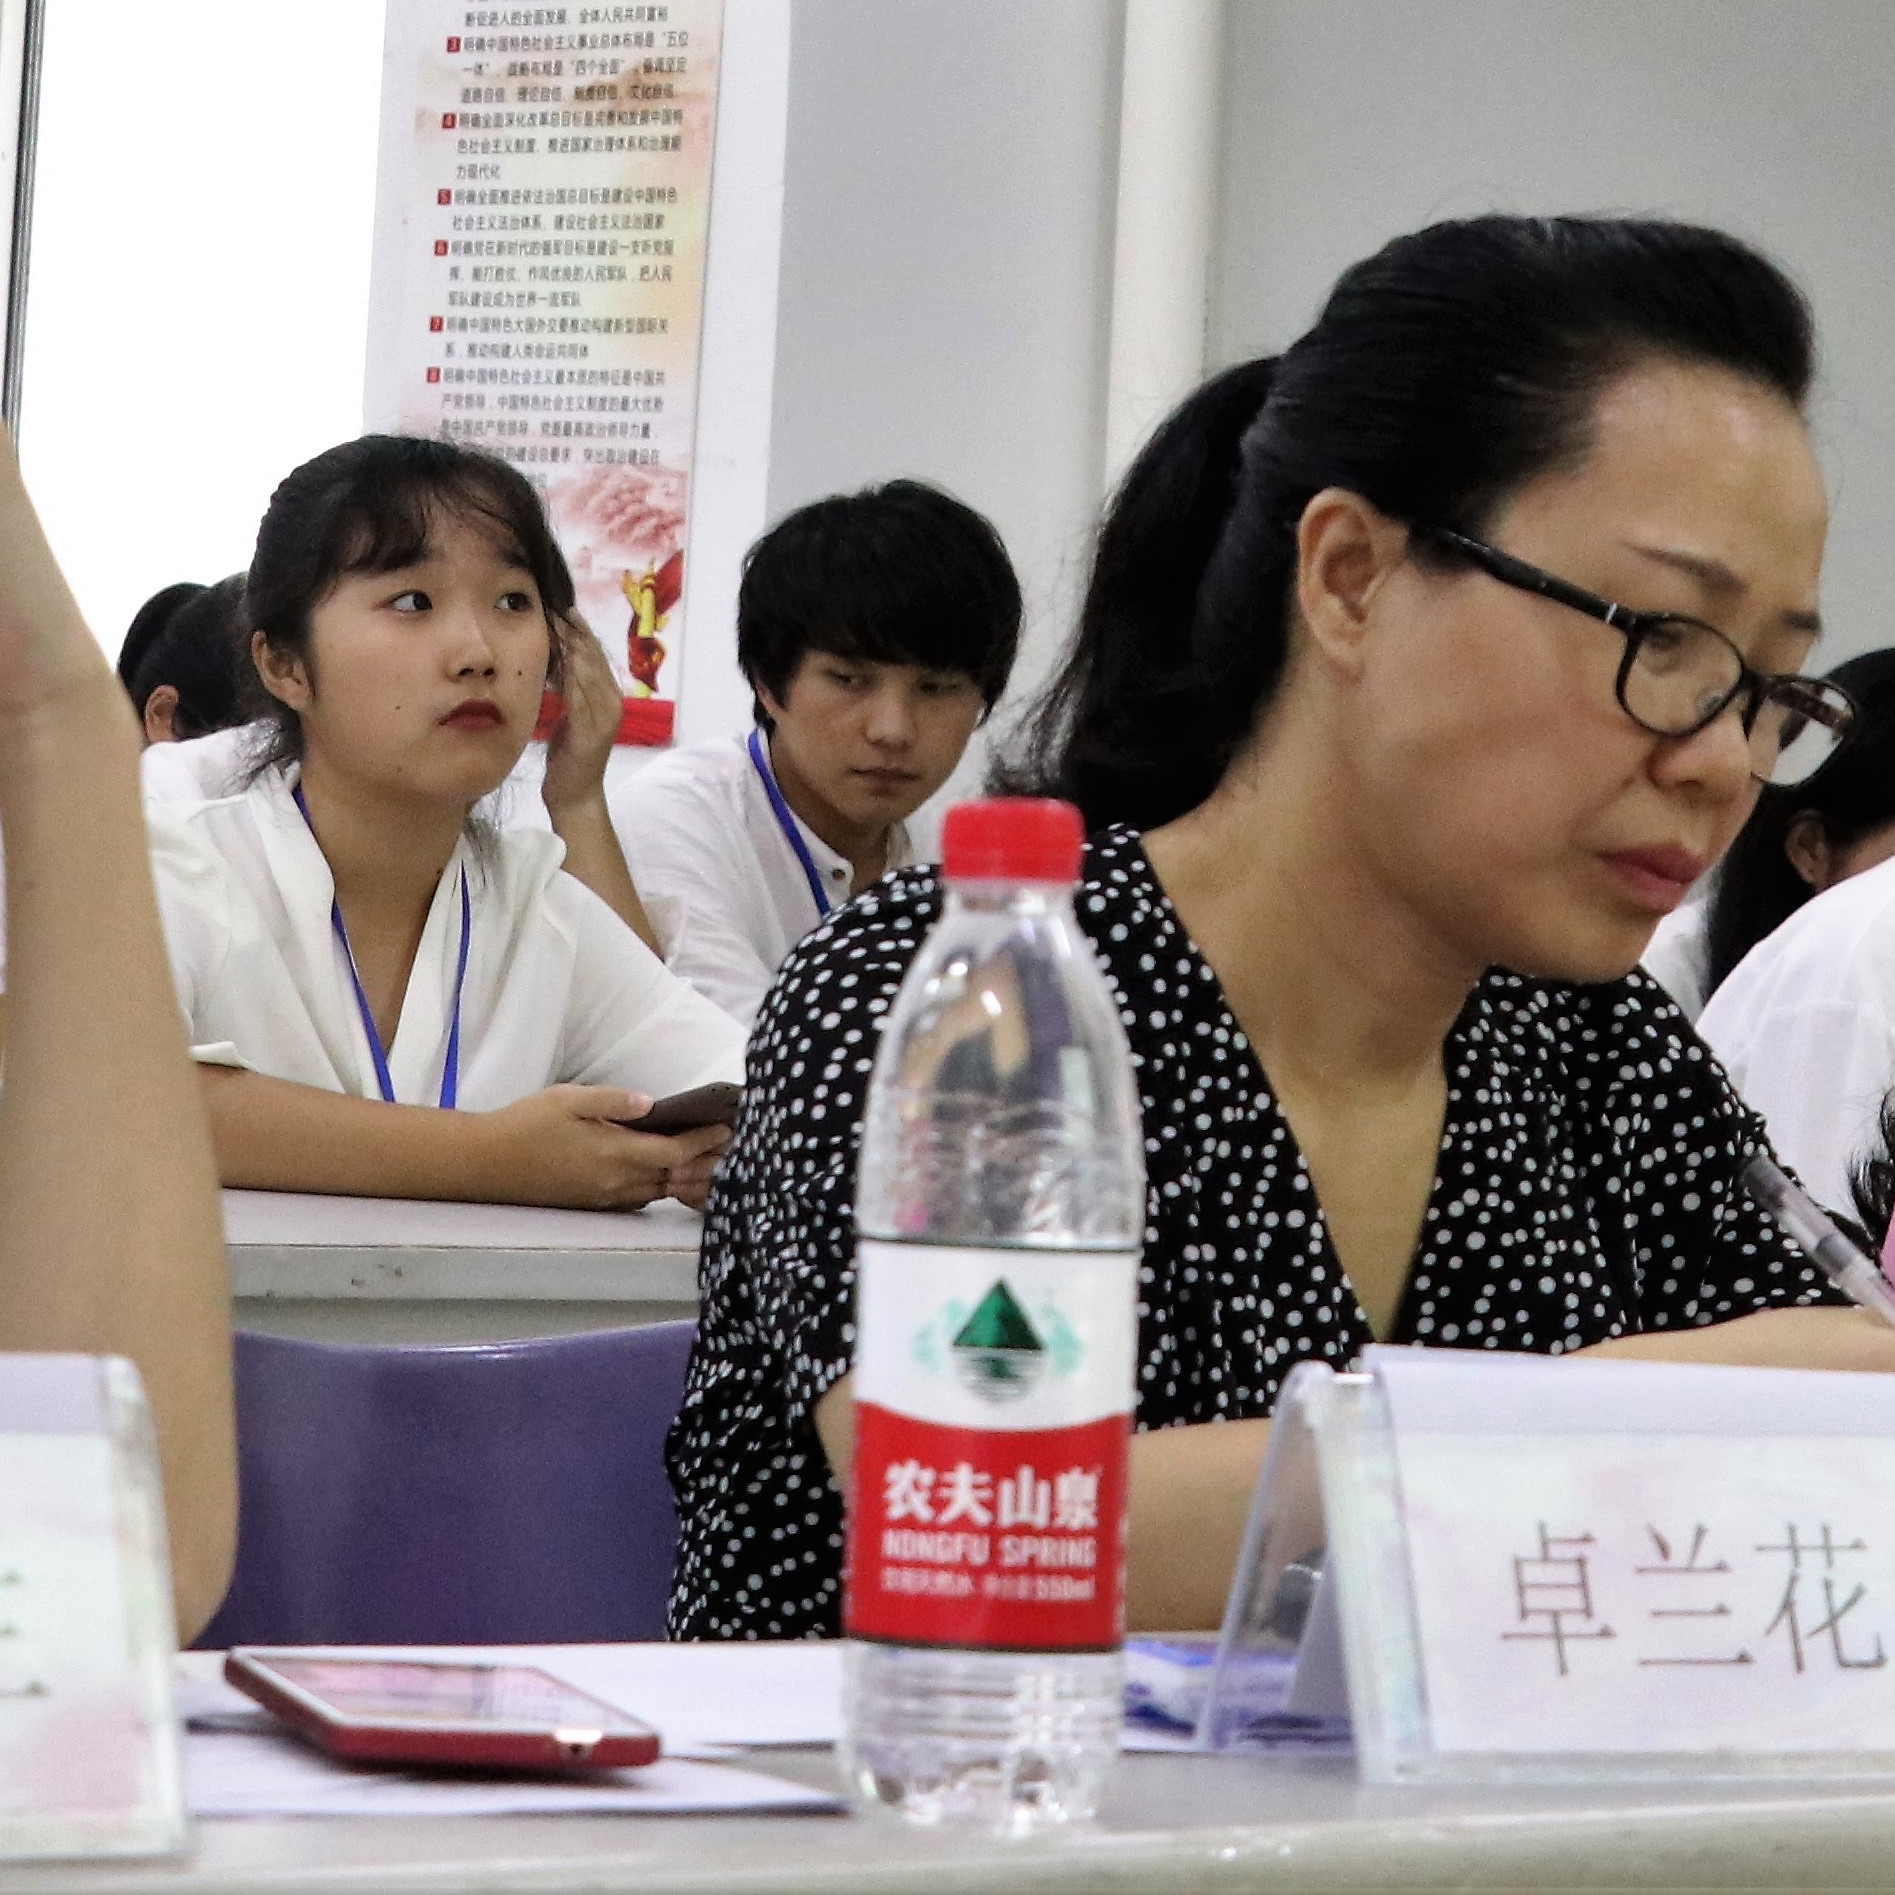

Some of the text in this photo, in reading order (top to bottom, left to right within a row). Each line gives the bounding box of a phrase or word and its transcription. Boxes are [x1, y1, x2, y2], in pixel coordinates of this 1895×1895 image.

[883, 1457, 1099, 1531] 农夫山泉
[998, 1534, 1098, 1568] SPRING
[1501, 1520, 1888, 1677] 卓兰花
